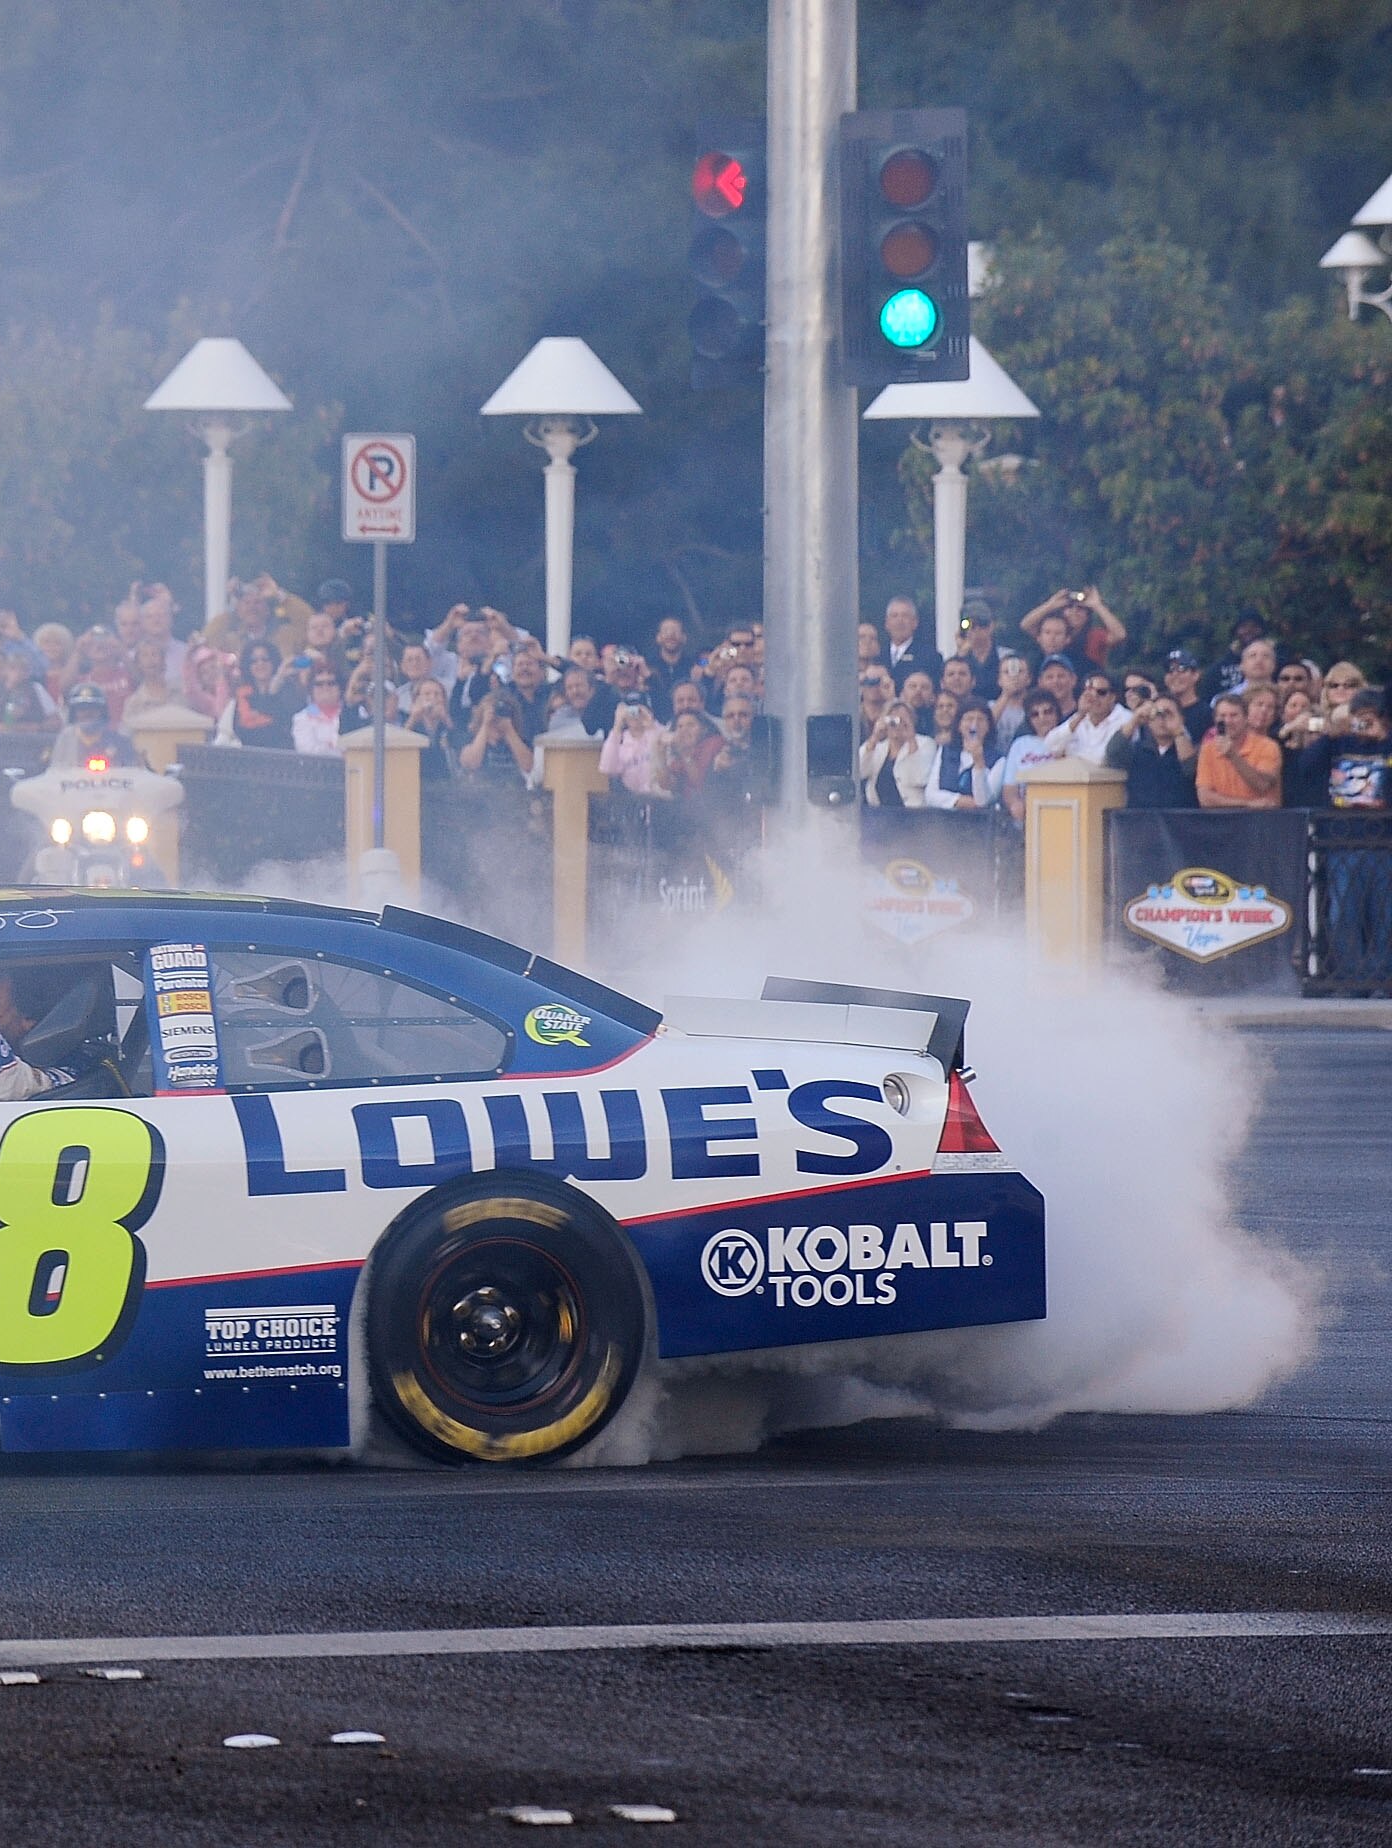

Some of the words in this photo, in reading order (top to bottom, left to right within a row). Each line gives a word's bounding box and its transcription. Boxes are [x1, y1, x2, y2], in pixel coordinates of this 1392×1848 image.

[60, 778, 134, 792] POLICE
[659, 876, 706, 911] Sprint
[152, 952, 207, 970] GUARD
[176, 993, 208, 1001] BOSCH
[177, 1003, 209, 1011] BOSCH
[534, 1008, 592, 1025] QUAKER
[162, 1026, 215, 1038] SIEMENS
[541, 1019, 585, 1032] STATE
[231, 1068, 894, 1198] LOWE'S
[768, 1221, 988, 1273] KOBALT
[768, 1273, 897, 1307] TOOLS
[205, 1320, 250, 1339] TOP
[255, 1317, 337, 1339] CHOICE
[206, 1341, 260, 1352] LUMBER
[266, 1338, 336, 1350] PRODUCTS
[204, 1363, 342, 1379] www.bethematch.org
